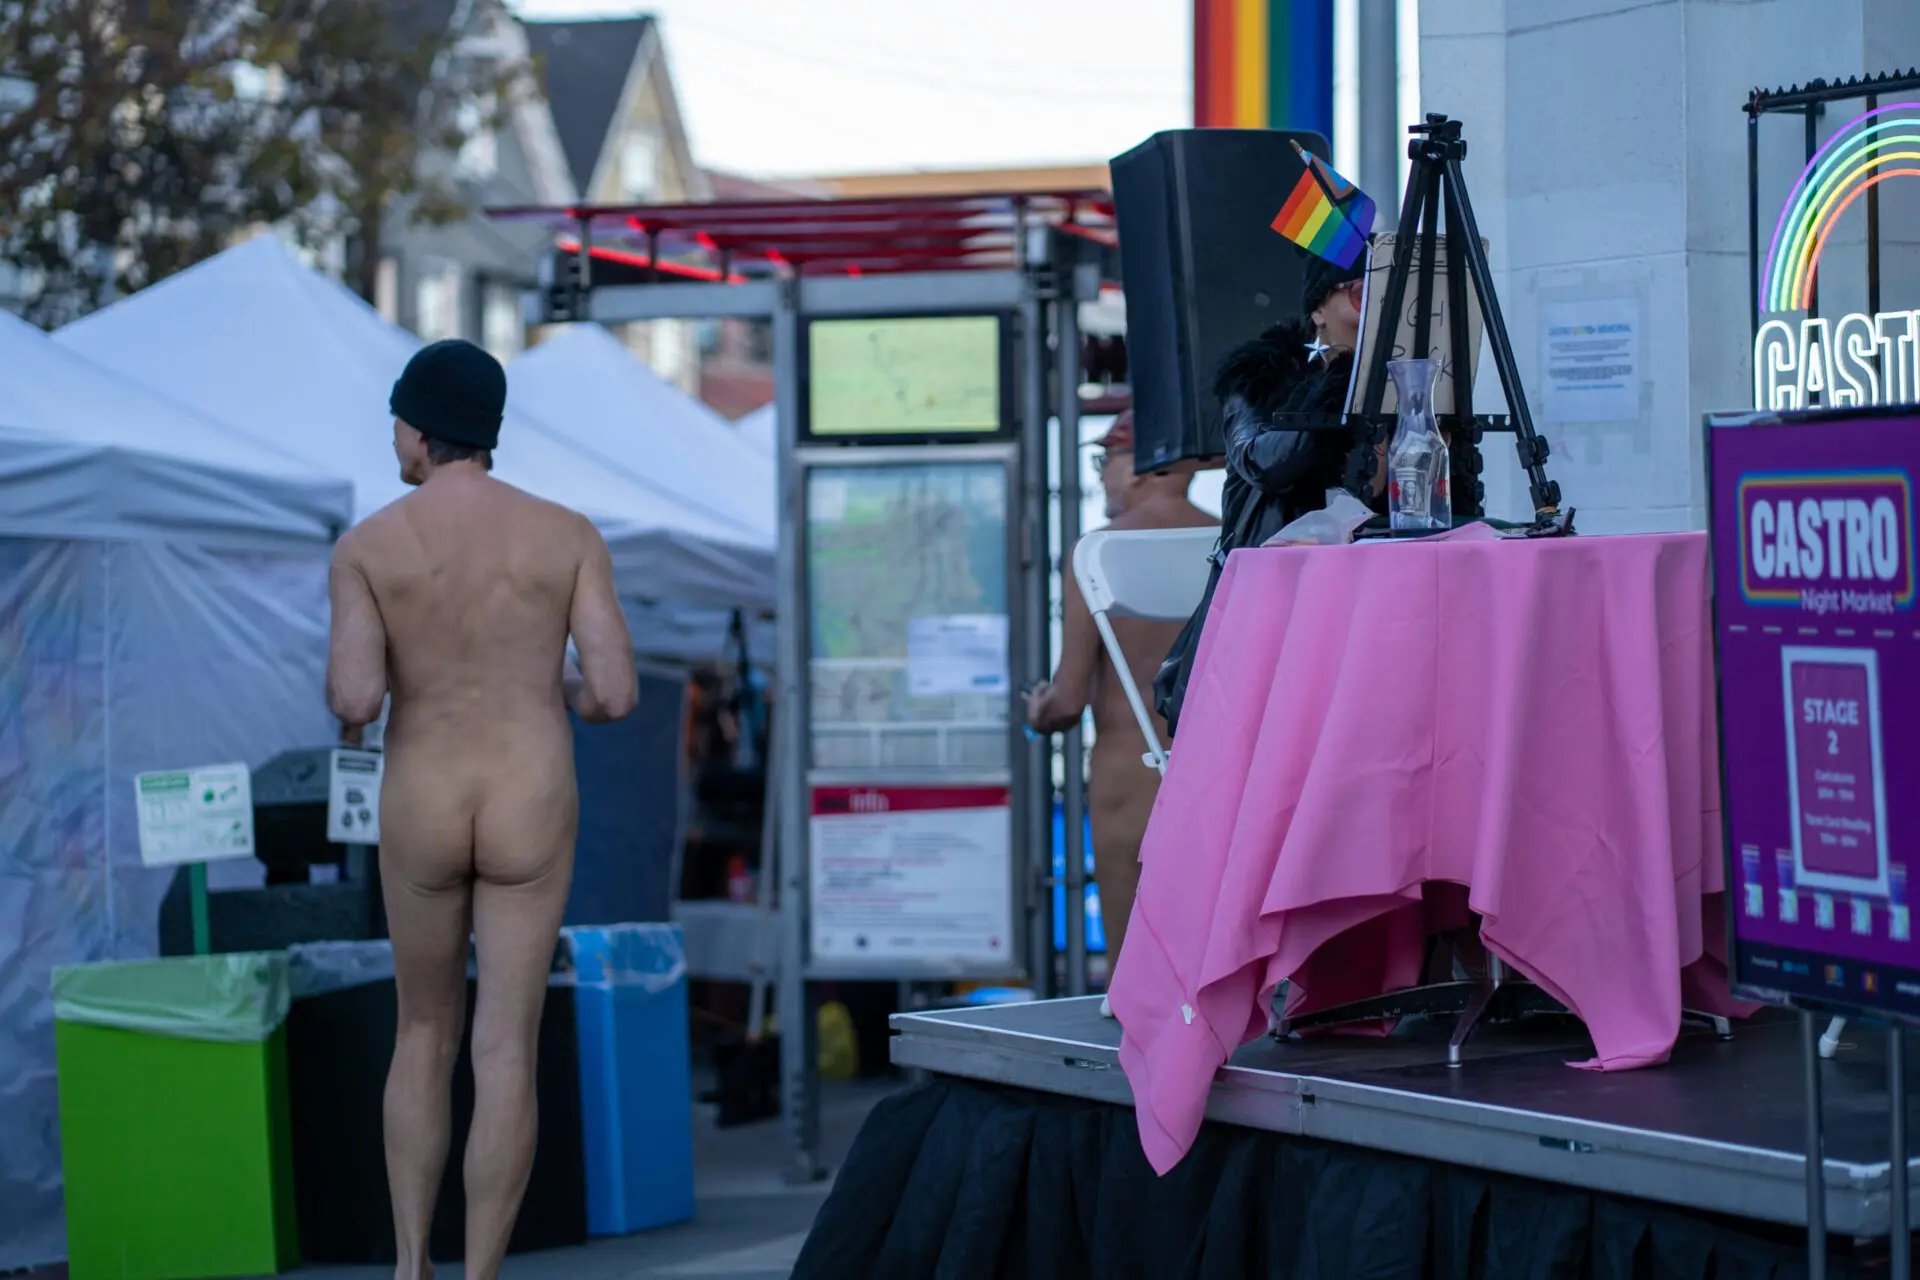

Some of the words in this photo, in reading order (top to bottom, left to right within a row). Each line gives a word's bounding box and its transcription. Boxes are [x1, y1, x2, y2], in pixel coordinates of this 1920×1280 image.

[1755, 311, 1920, 412] CAST
[1751, 496, 1899, 581] CASTRO
[1801, 588, 1840, 615] Night
[1841, 588, 1895, 614] Market
[1804, 698, 1859, 725] STAGE
[1827, 729, 1839, 756] 2
